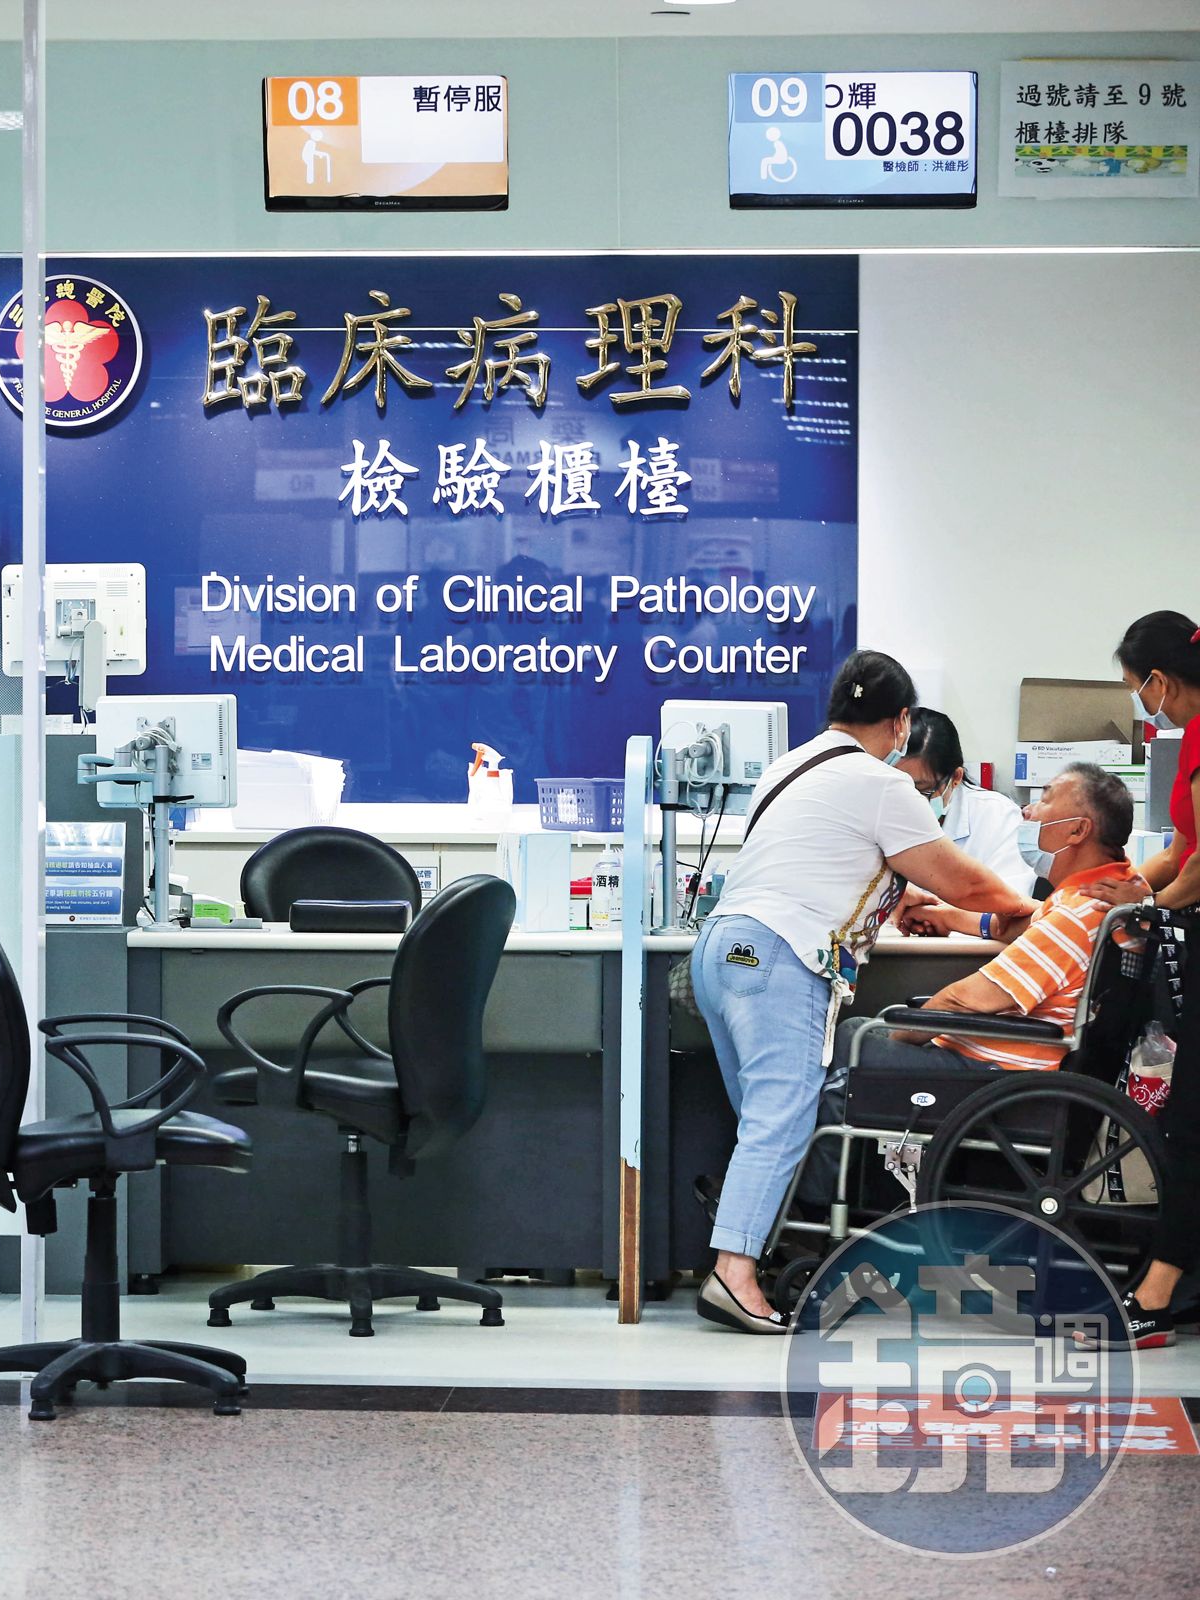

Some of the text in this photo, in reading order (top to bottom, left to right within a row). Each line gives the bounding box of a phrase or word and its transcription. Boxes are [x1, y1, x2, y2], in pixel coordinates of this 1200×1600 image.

[288, 81, 344, 121] 08
[413, 85, 503, 112] 暫停服
[751, 77, 808, 118] 09
[1016, 83, 1187, 108] 過號請至 9 號
[832, 111, 965, 156] 0038
[1014, 121, 1128, 145] 櫃檯排隊
[9, 280, 126, 328] 三總醫院
[202, 291, 817, 409] 臨床病理科
[52, 378, 122, 418] GENERAL HOSPITAL
[338, 437, 692, 516] 檢驗櫃檯
[201, 572, 817, 623] Division of Clinical Pathology
[210, 636, 807, 682] Medical Laboratory Counter
[595, 874, 620, 888] 酒精
